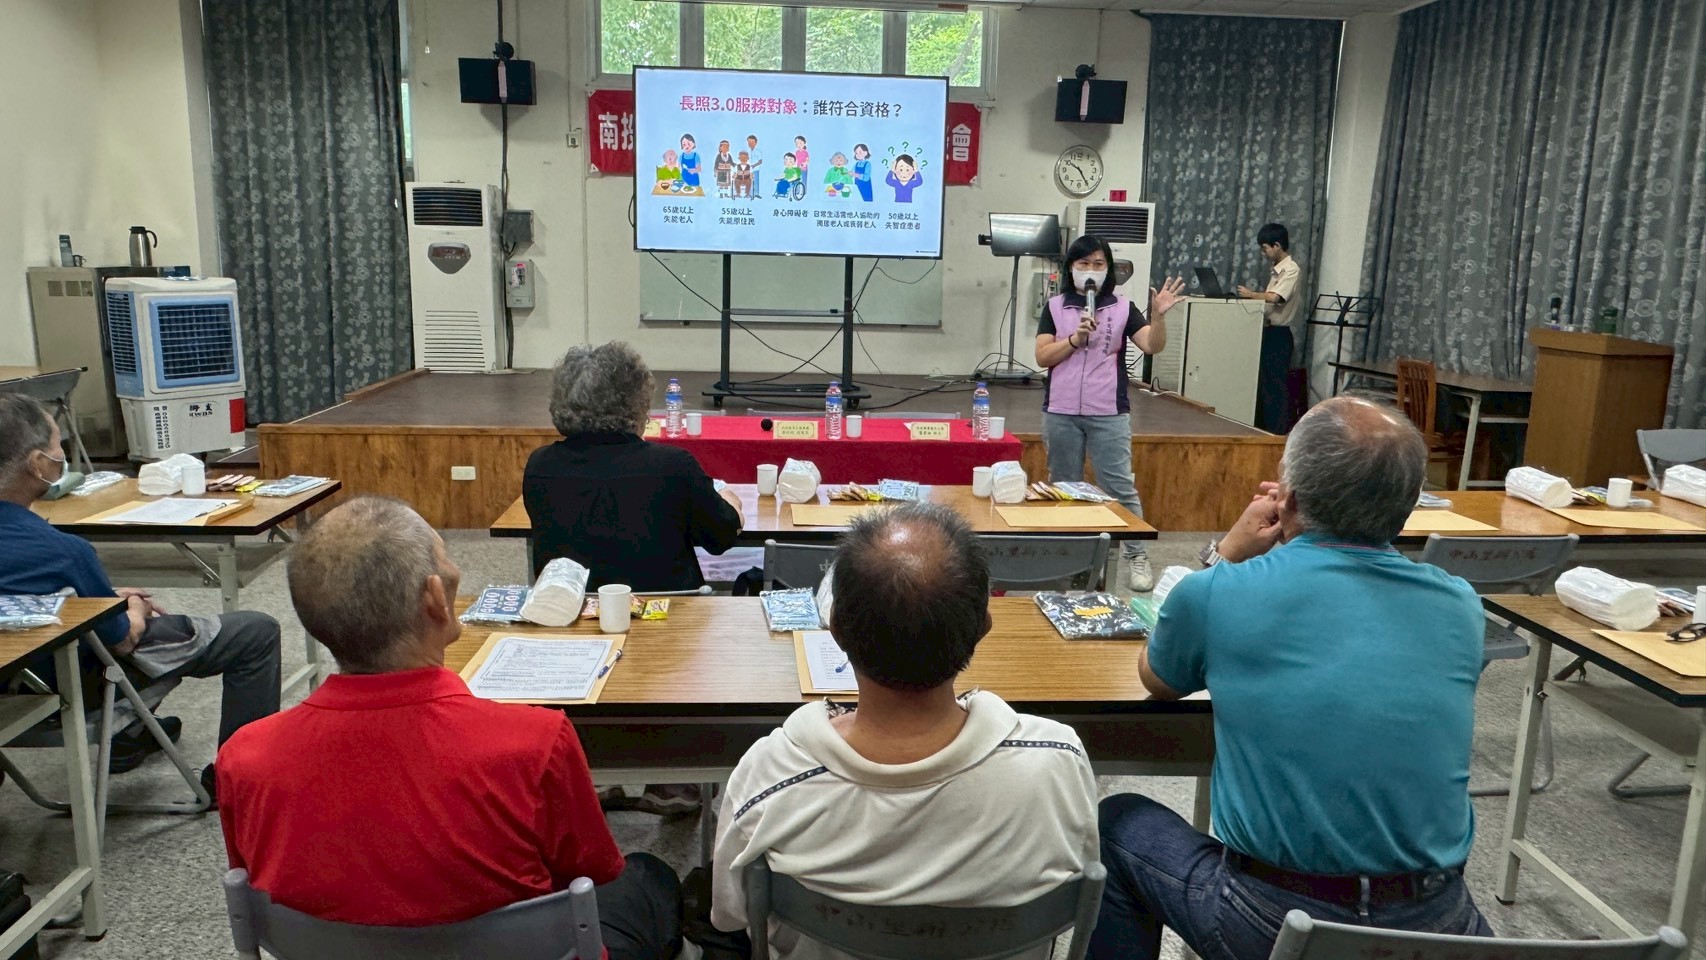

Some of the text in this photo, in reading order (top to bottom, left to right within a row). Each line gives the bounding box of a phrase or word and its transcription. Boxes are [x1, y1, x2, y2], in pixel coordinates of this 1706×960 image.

[679, 95, 902, 118] 長照3.0服務對象：誰符合資格？
[663, 206, 694, 214] 65歲以上
[721, 207, 752, 216] 55歲以上
[888, 212, 918, 221] 50歲以上
